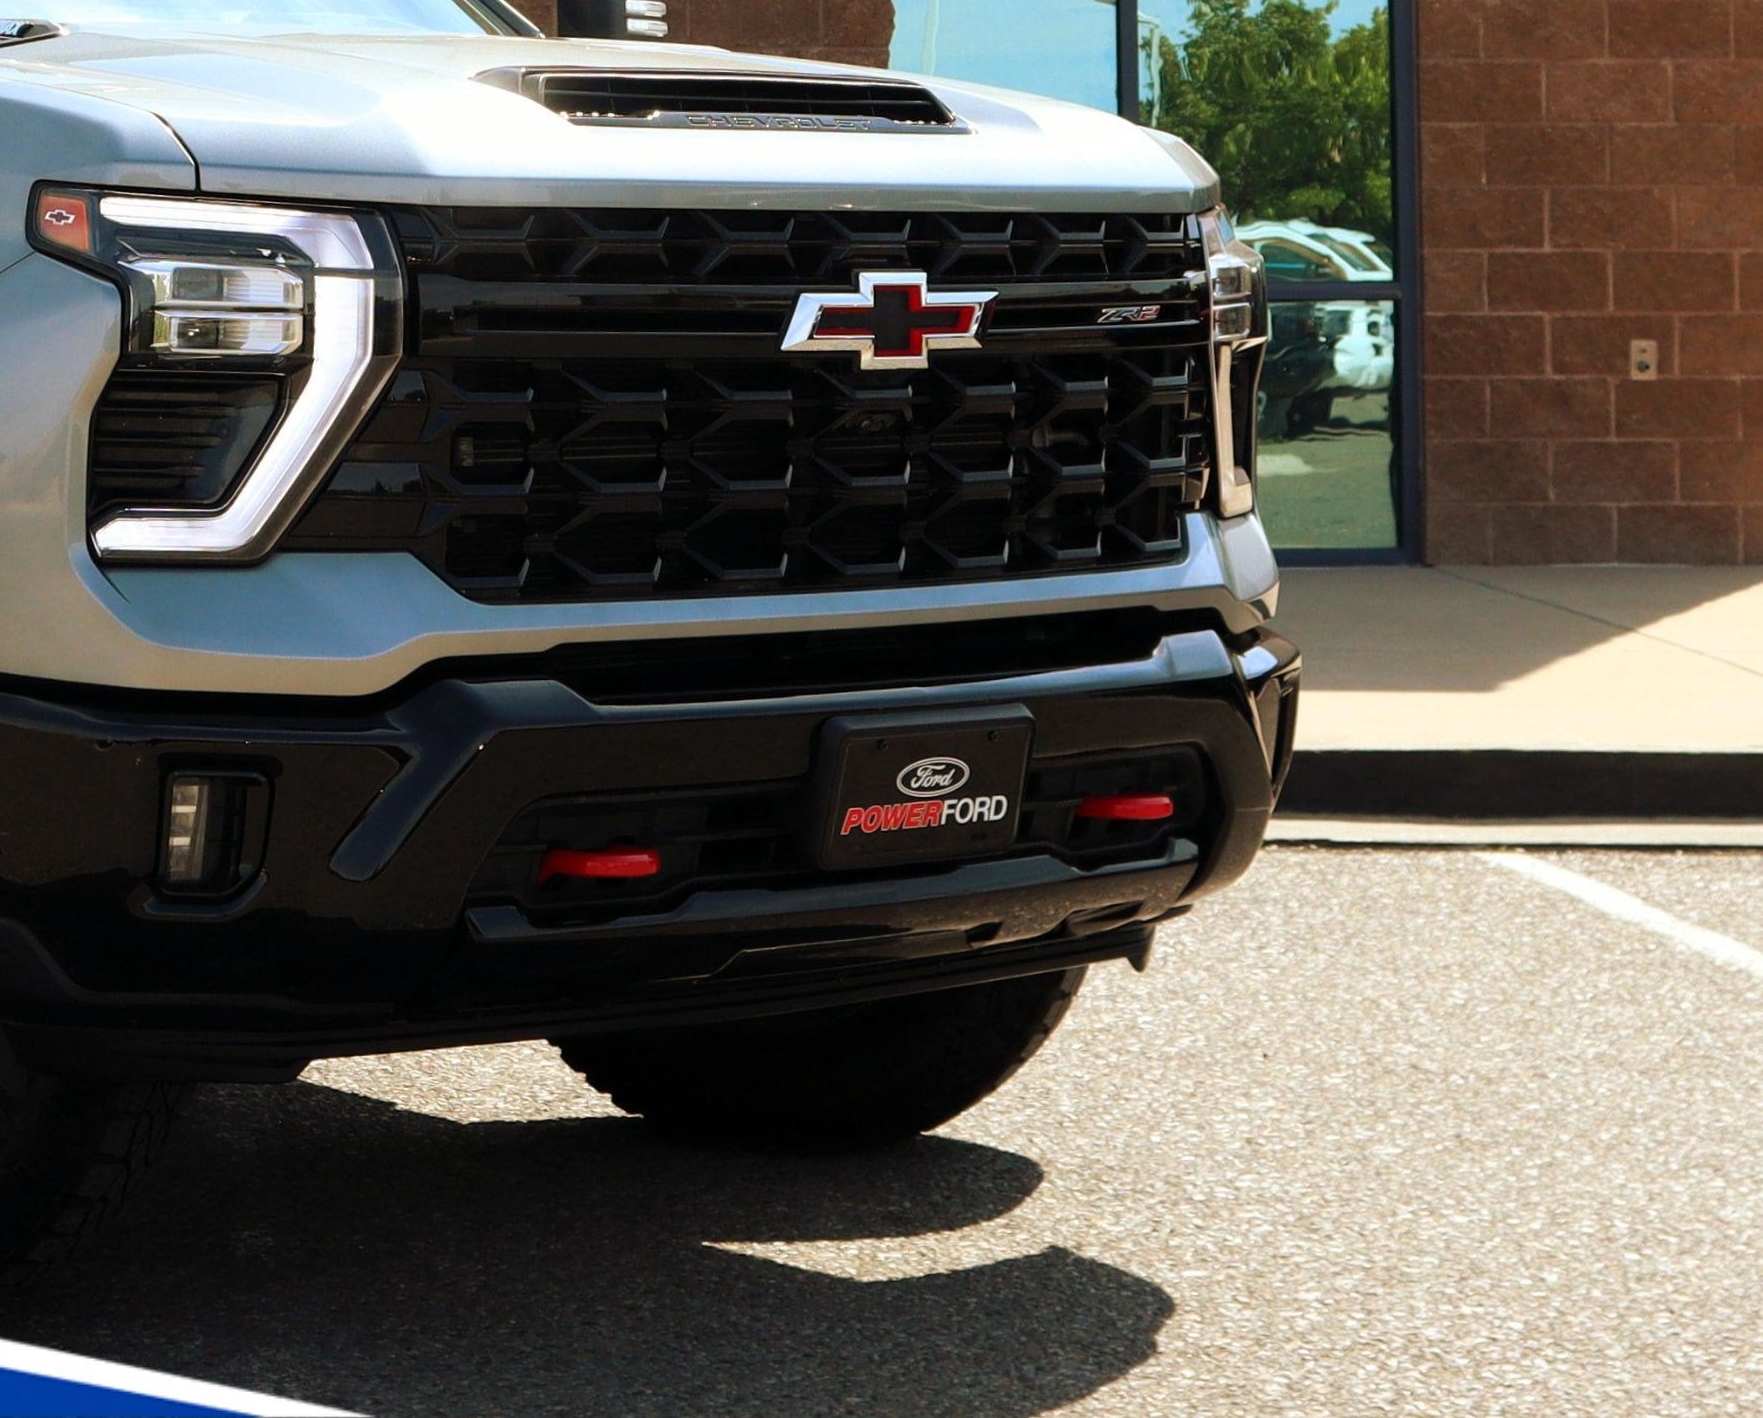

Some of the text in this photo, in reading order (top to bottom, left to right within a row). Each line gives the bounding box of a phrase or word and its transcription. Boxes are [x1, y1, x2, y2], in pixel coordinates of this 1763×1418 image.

[686, 114, 871, 131] CHEVROLET
[1097, 304, 1161, 324] ZR2
[910, 764, 954, 789] Ford
[840, 795, 1008, 836] POWERFORD
